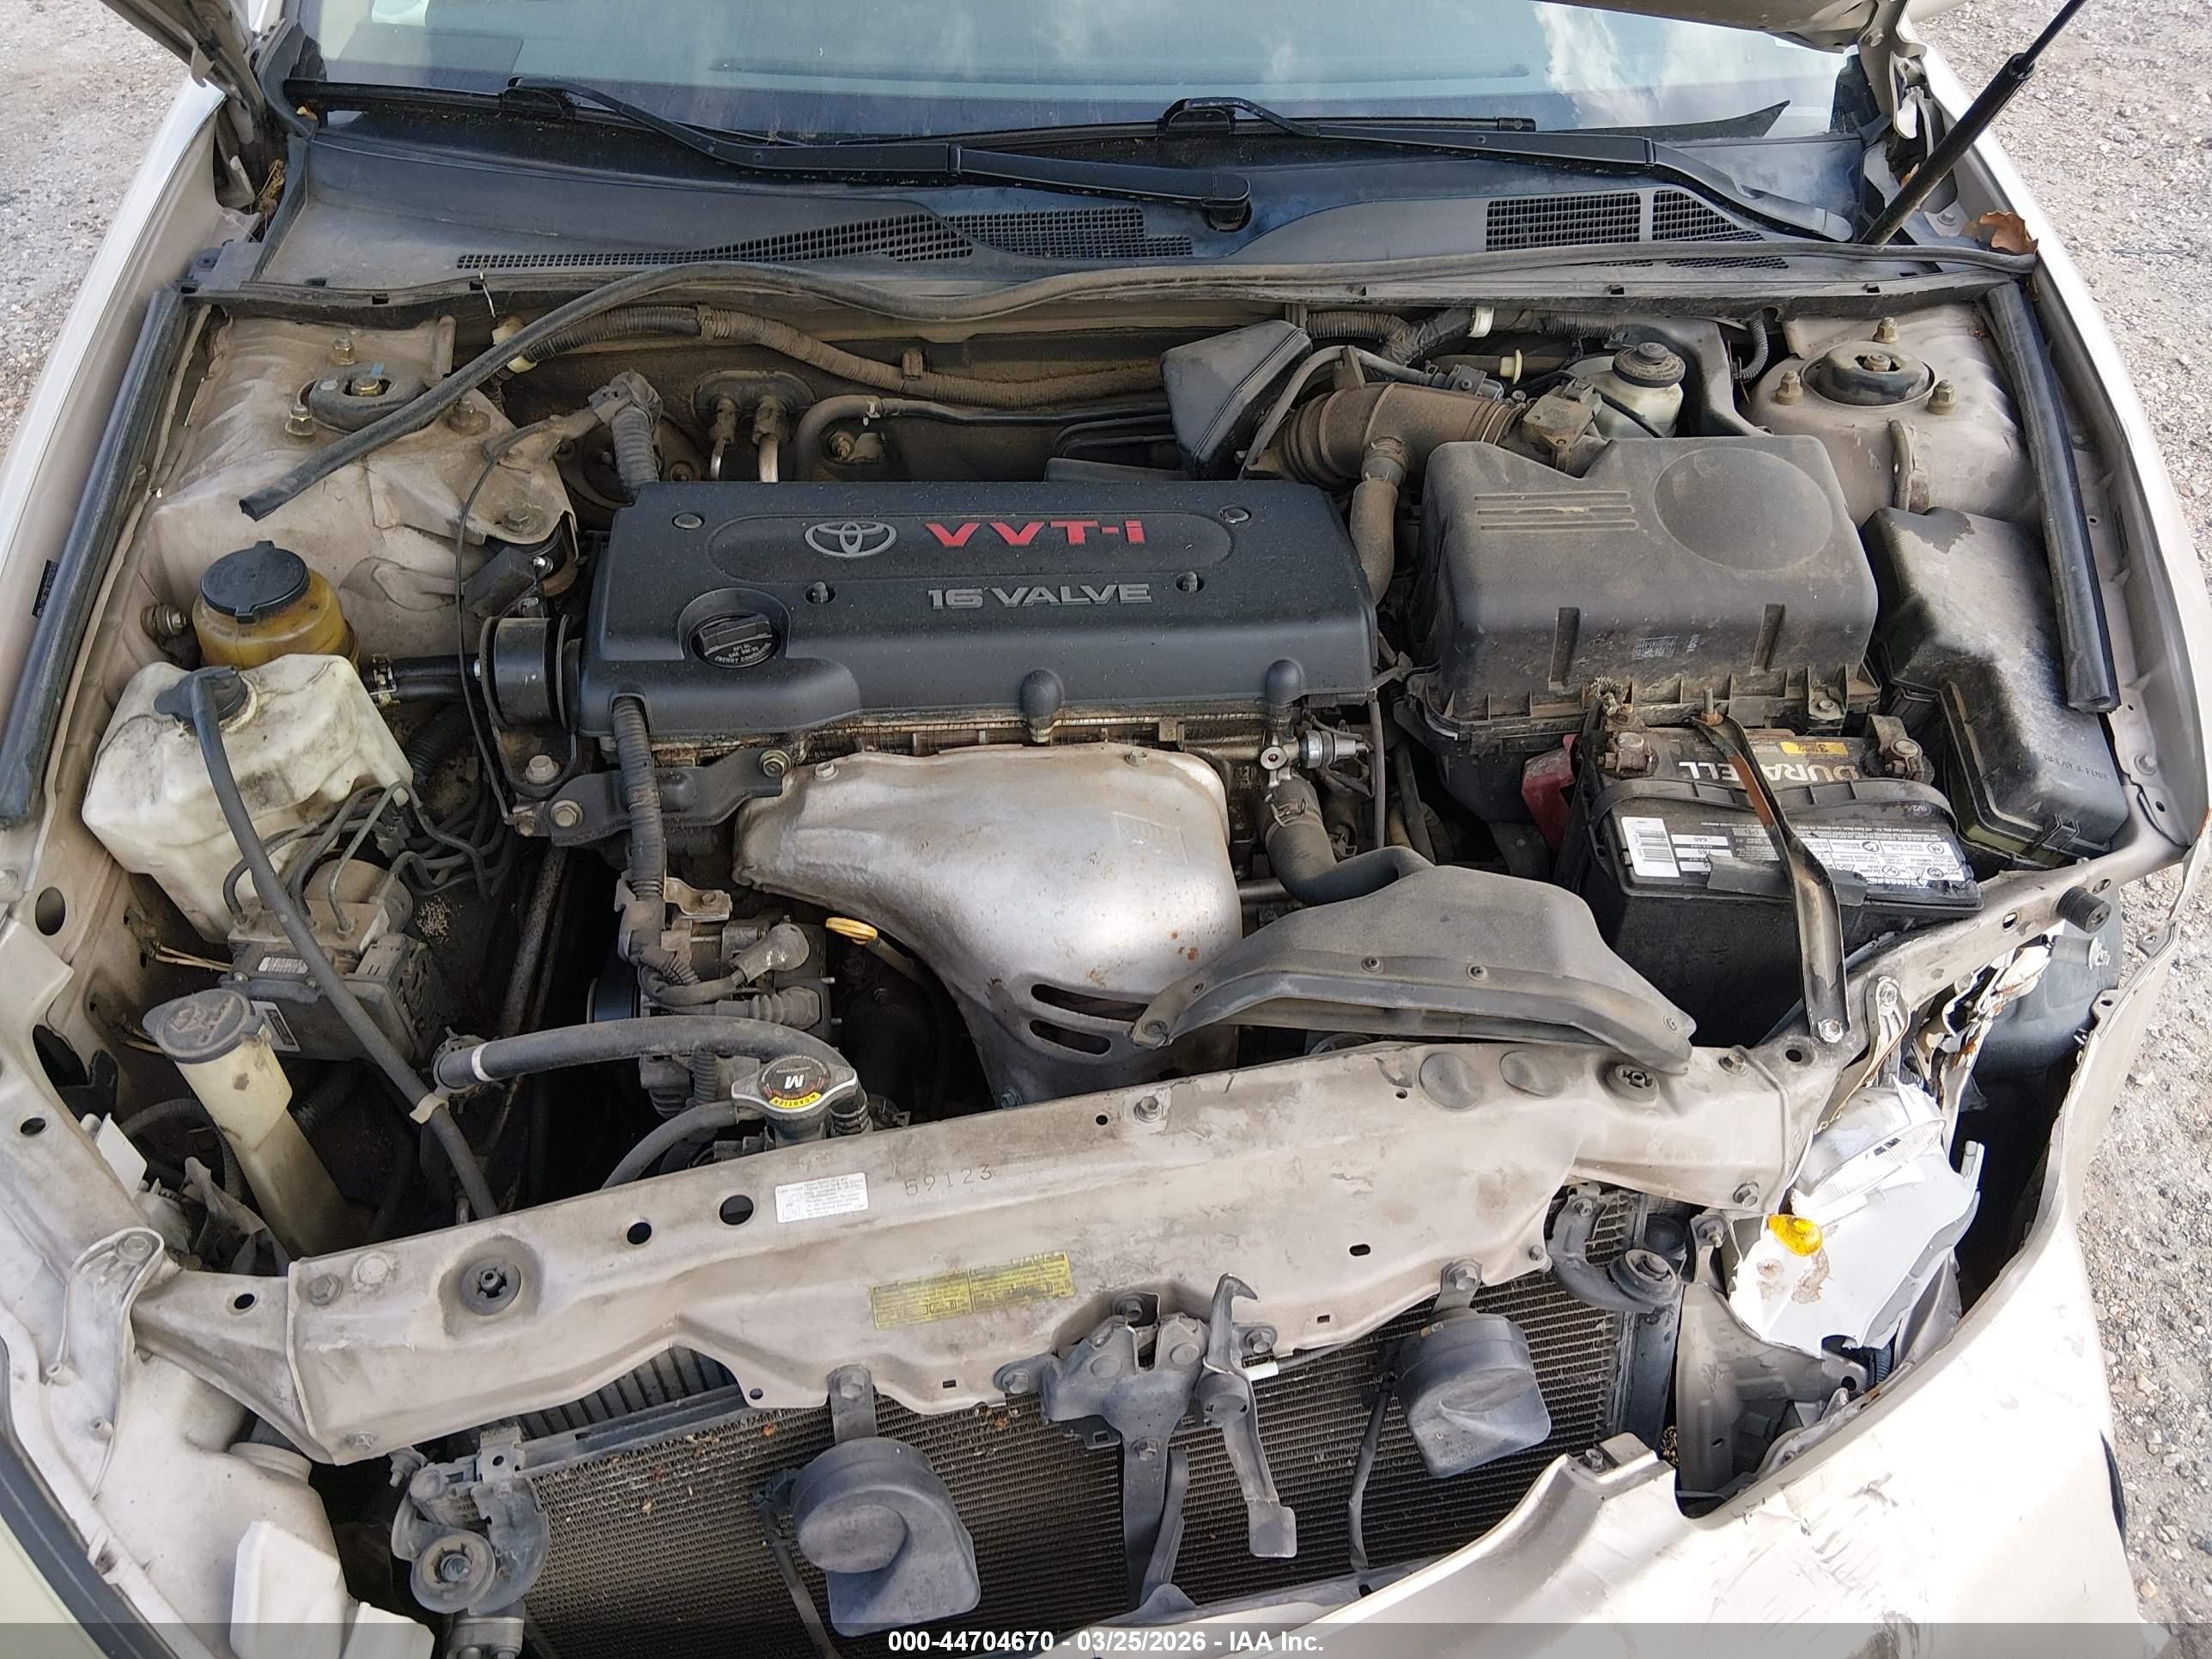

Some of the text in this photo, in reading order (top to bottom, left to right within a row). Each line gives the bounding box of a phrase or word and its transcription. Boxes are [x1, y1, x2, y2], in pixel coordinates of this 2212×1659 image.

[925, 520, 1146, 547] VVT-i
[928, 584, 1152, 609] 16 VALVE
[1679, 761, 1860, 782] DURAELL
[784, 1074, 805, 1090] M
[774, 1097, 811, 1107] CAUTION
[904, 1164, 993, 1196] 59123
